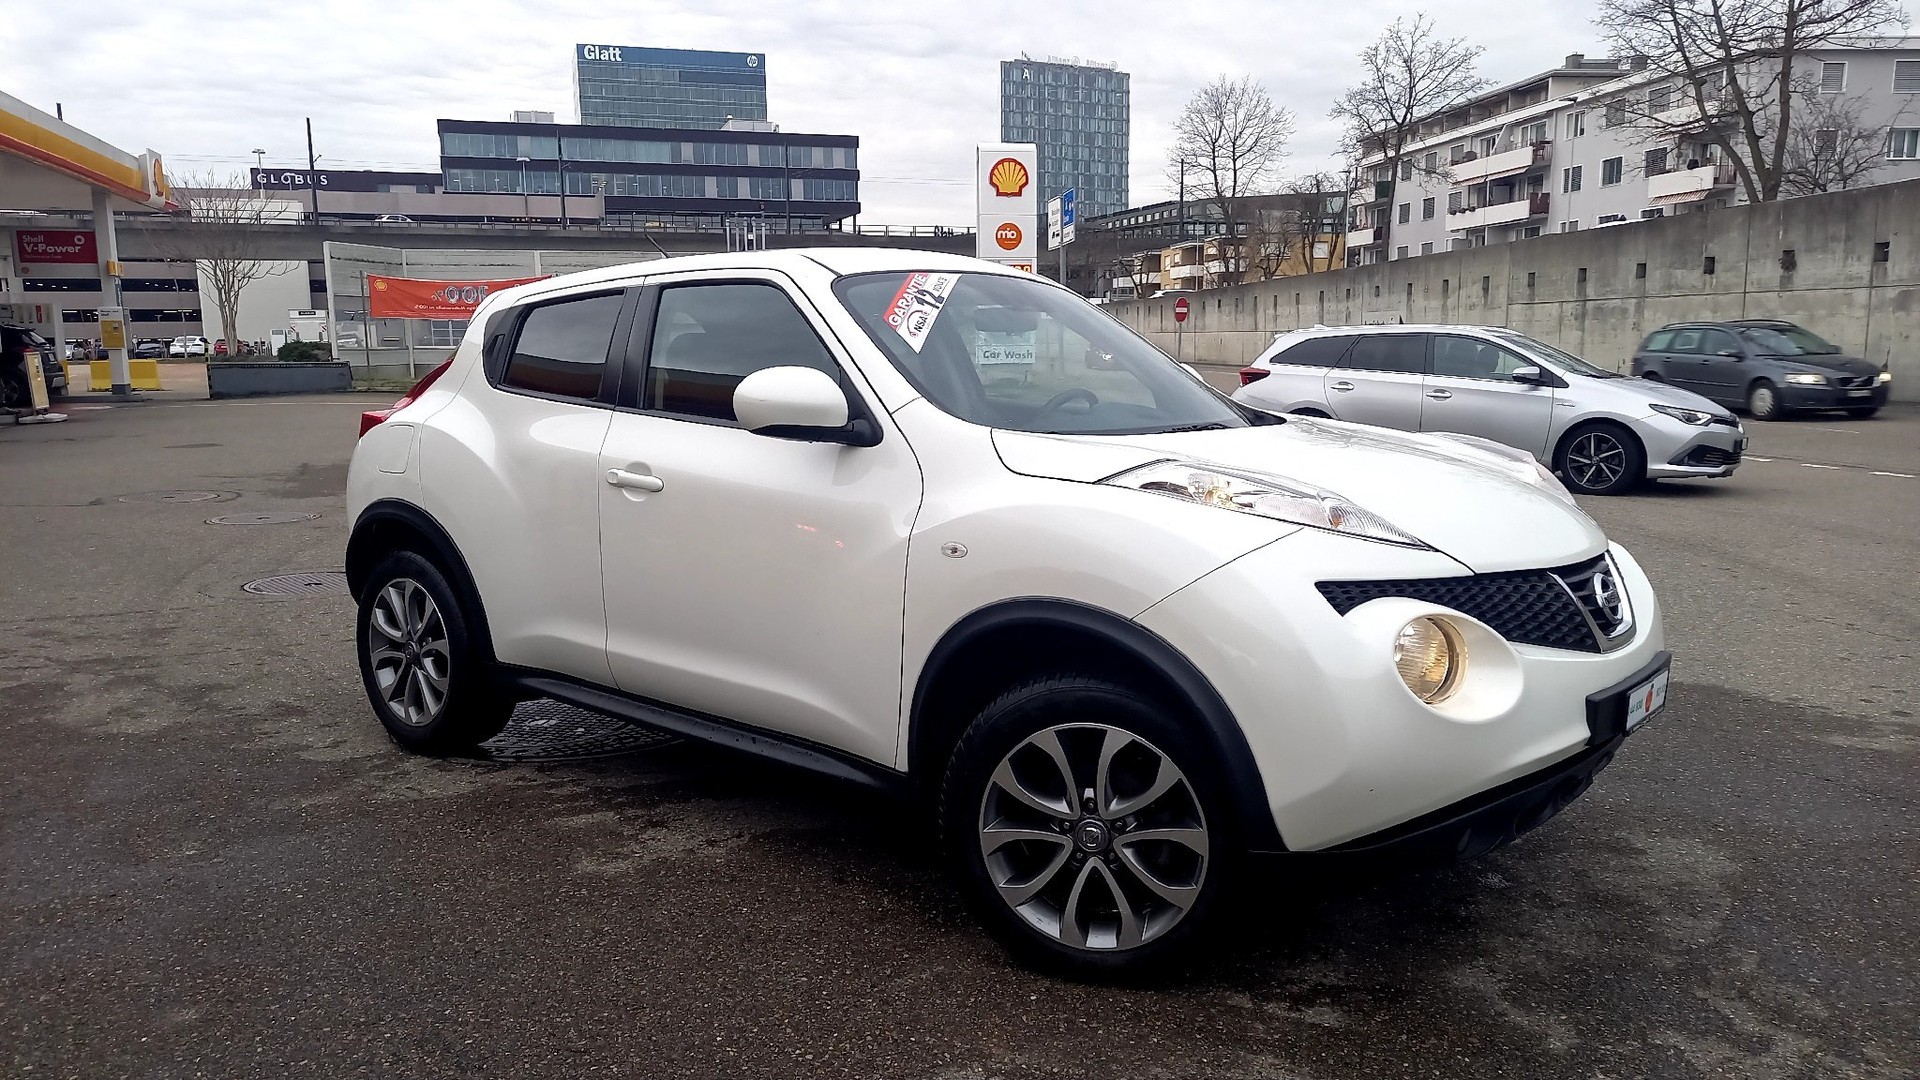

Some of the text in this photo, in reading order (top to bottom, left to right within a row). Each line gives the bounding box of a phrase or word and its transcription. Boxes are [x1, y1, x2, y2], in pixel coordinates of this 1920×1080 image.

[584, 45, 622, 62] Glatt
[747, 55, 758, 68] hp
[257, 173, 328, 185] GLOBUS
[22, 235, 43, 243] Shell
[997, 228, 1017, 239] mio
[24, 243, 81, 253] V-Power
[914, 289, 944, 309] 12
[914, 315, 928, 332] NSA
[983, 349, 1033, 359] Car Wash
